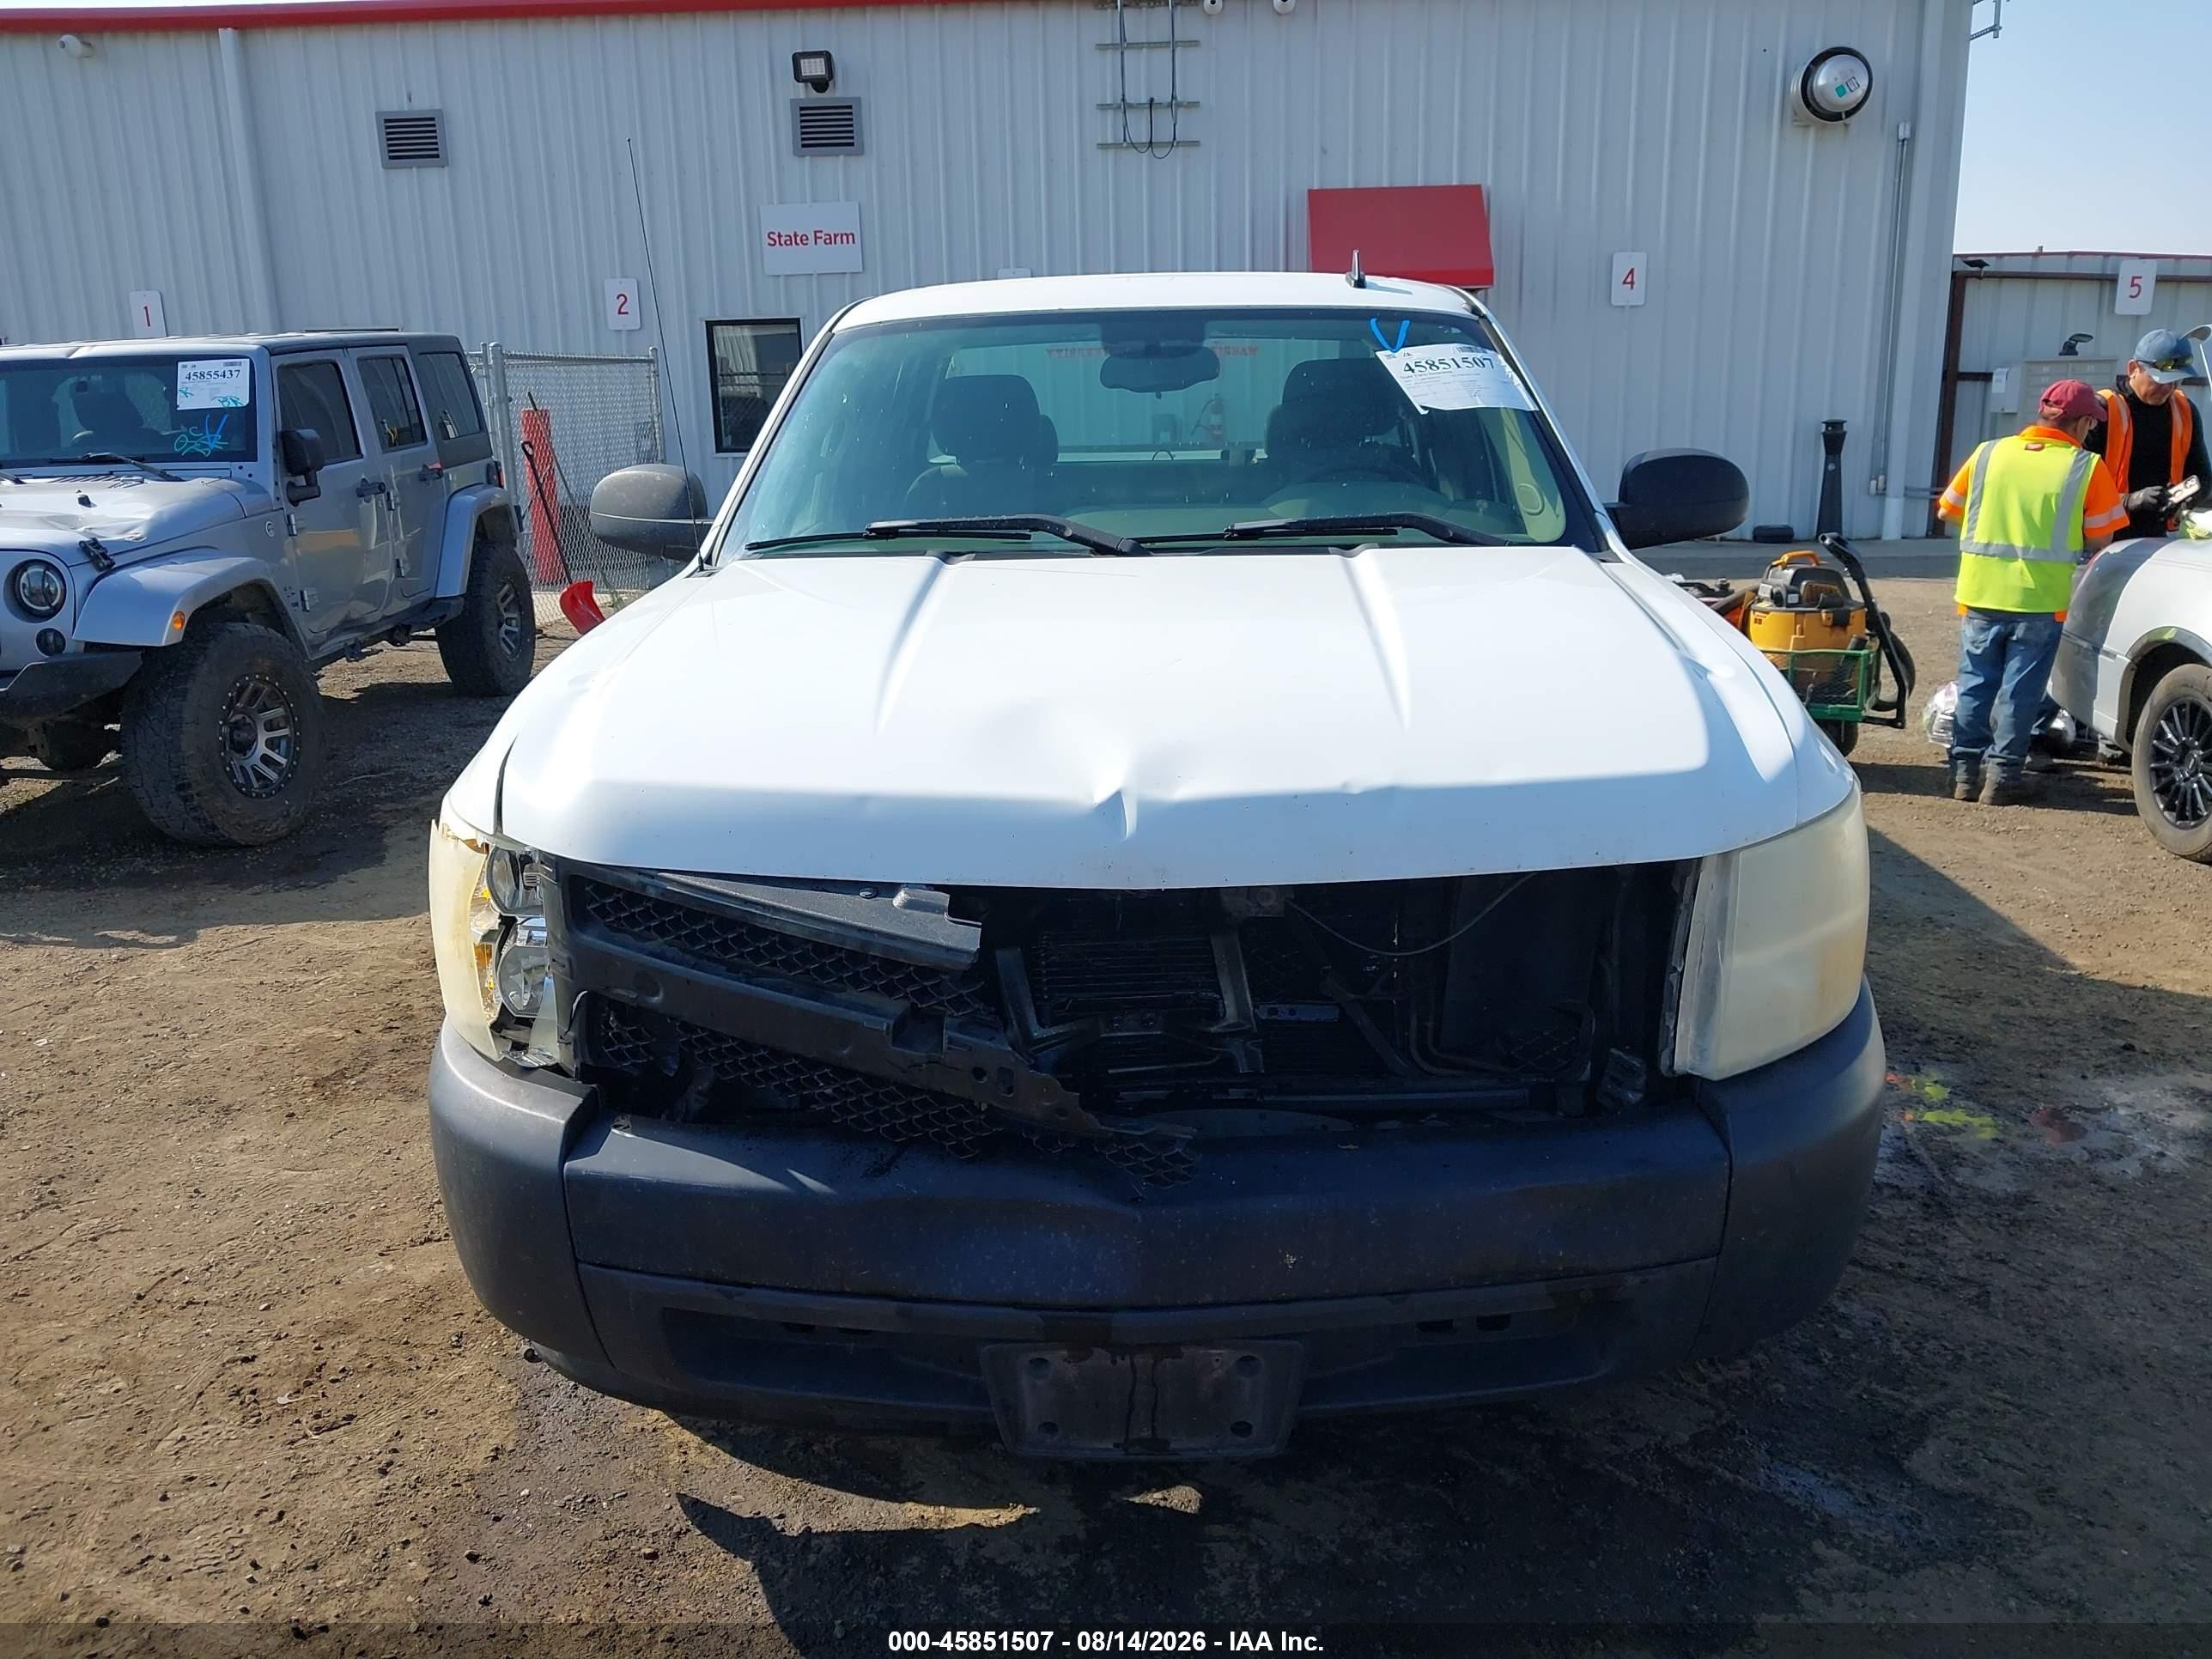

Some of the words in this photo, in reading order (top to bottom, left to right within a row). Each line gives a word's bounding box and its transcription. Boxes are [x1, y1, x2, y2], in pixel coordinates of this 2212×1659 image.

[767, 231, 809, 246] State
[813, 229, 856, 246] Farm
[1622, 267, 1635, 290] 4
[2129, 275, 2142, 299] 5
[616, 293, 629, 315] 2
[143, 305, 151, 327] 1
[185, 368, 241, 381] 45855437
[1402, 356, 1495, 374] 45851507
